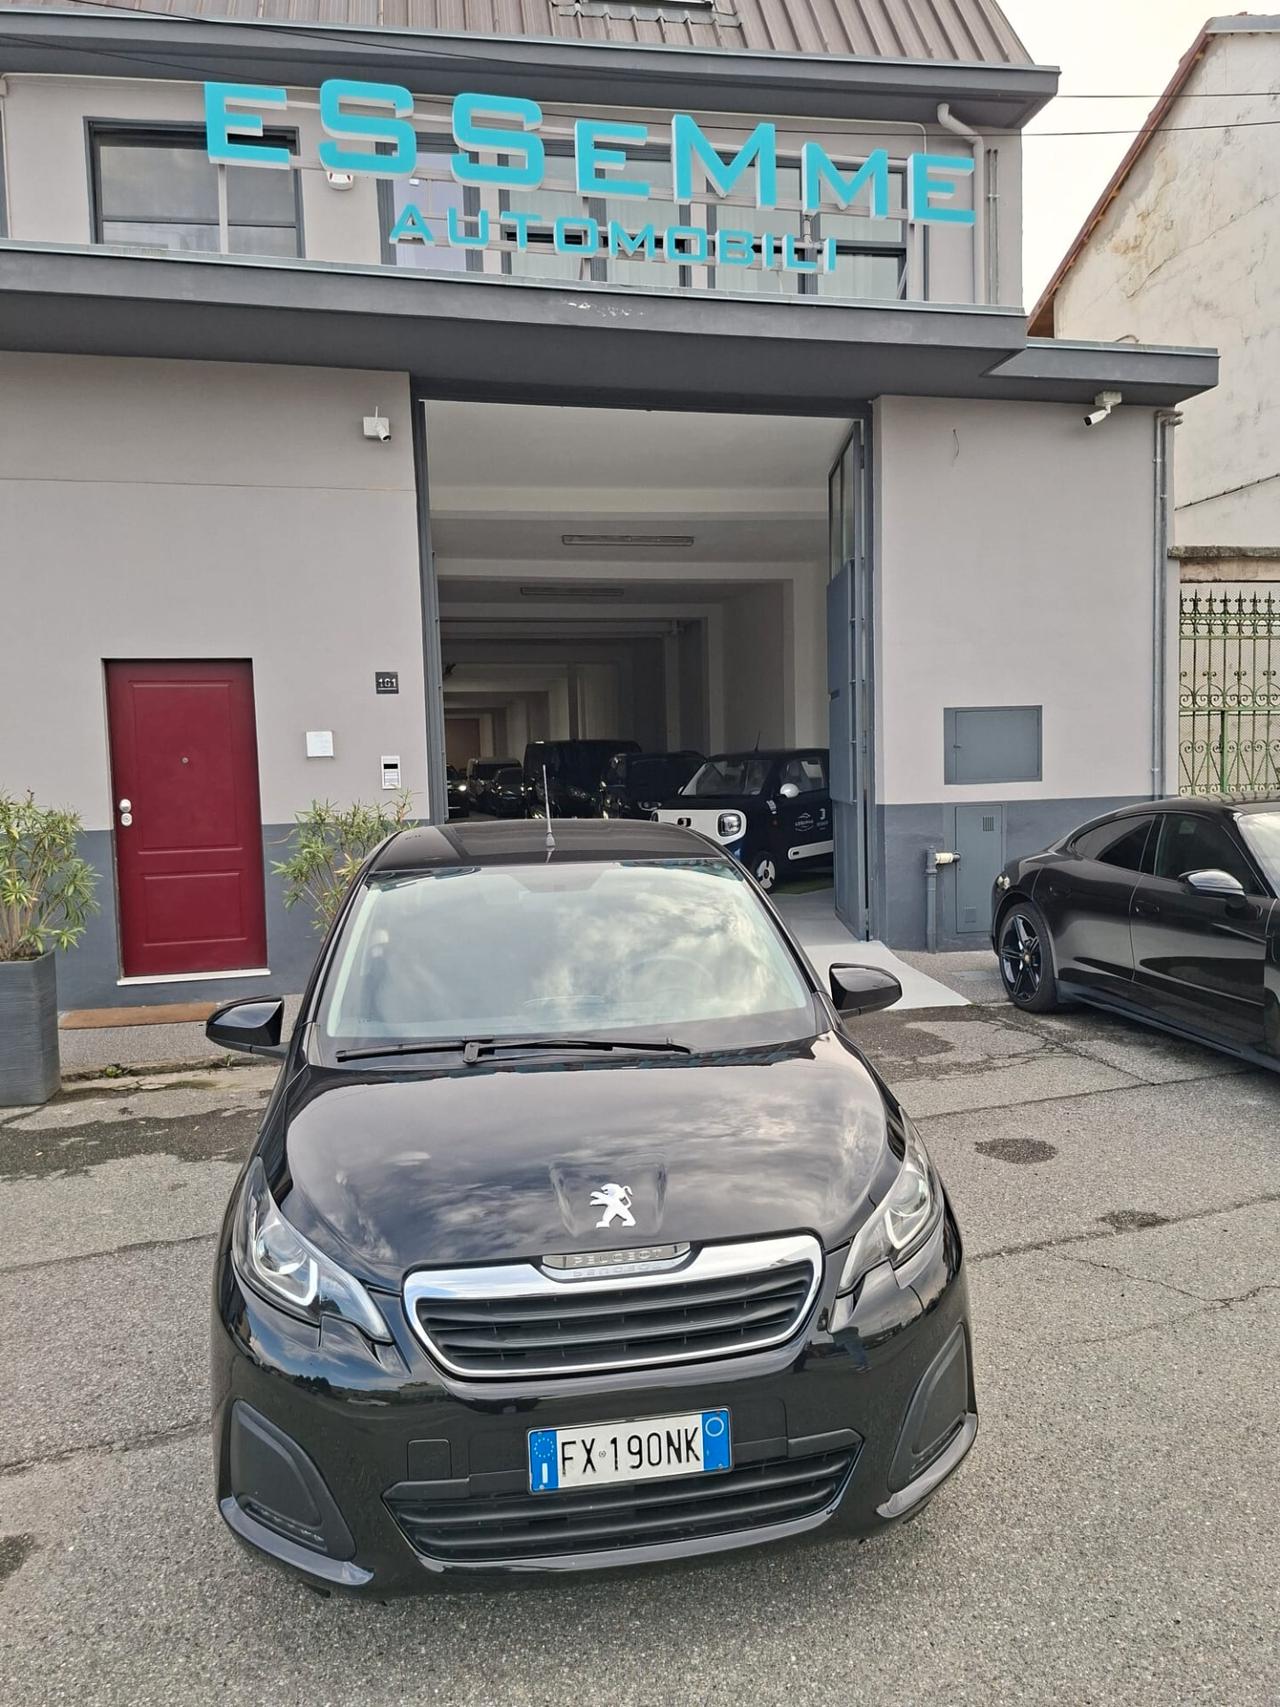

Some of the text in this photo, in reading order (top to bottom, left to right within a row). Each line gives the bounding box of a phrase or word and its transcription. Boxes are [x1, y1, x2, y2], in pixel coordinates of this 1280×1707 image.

[203, 79, 976, 226] ESSEMME
[389, 203, 836, 273] AUTOMOBILI
[573, 1249, 662, 1265] PEUGEOT
